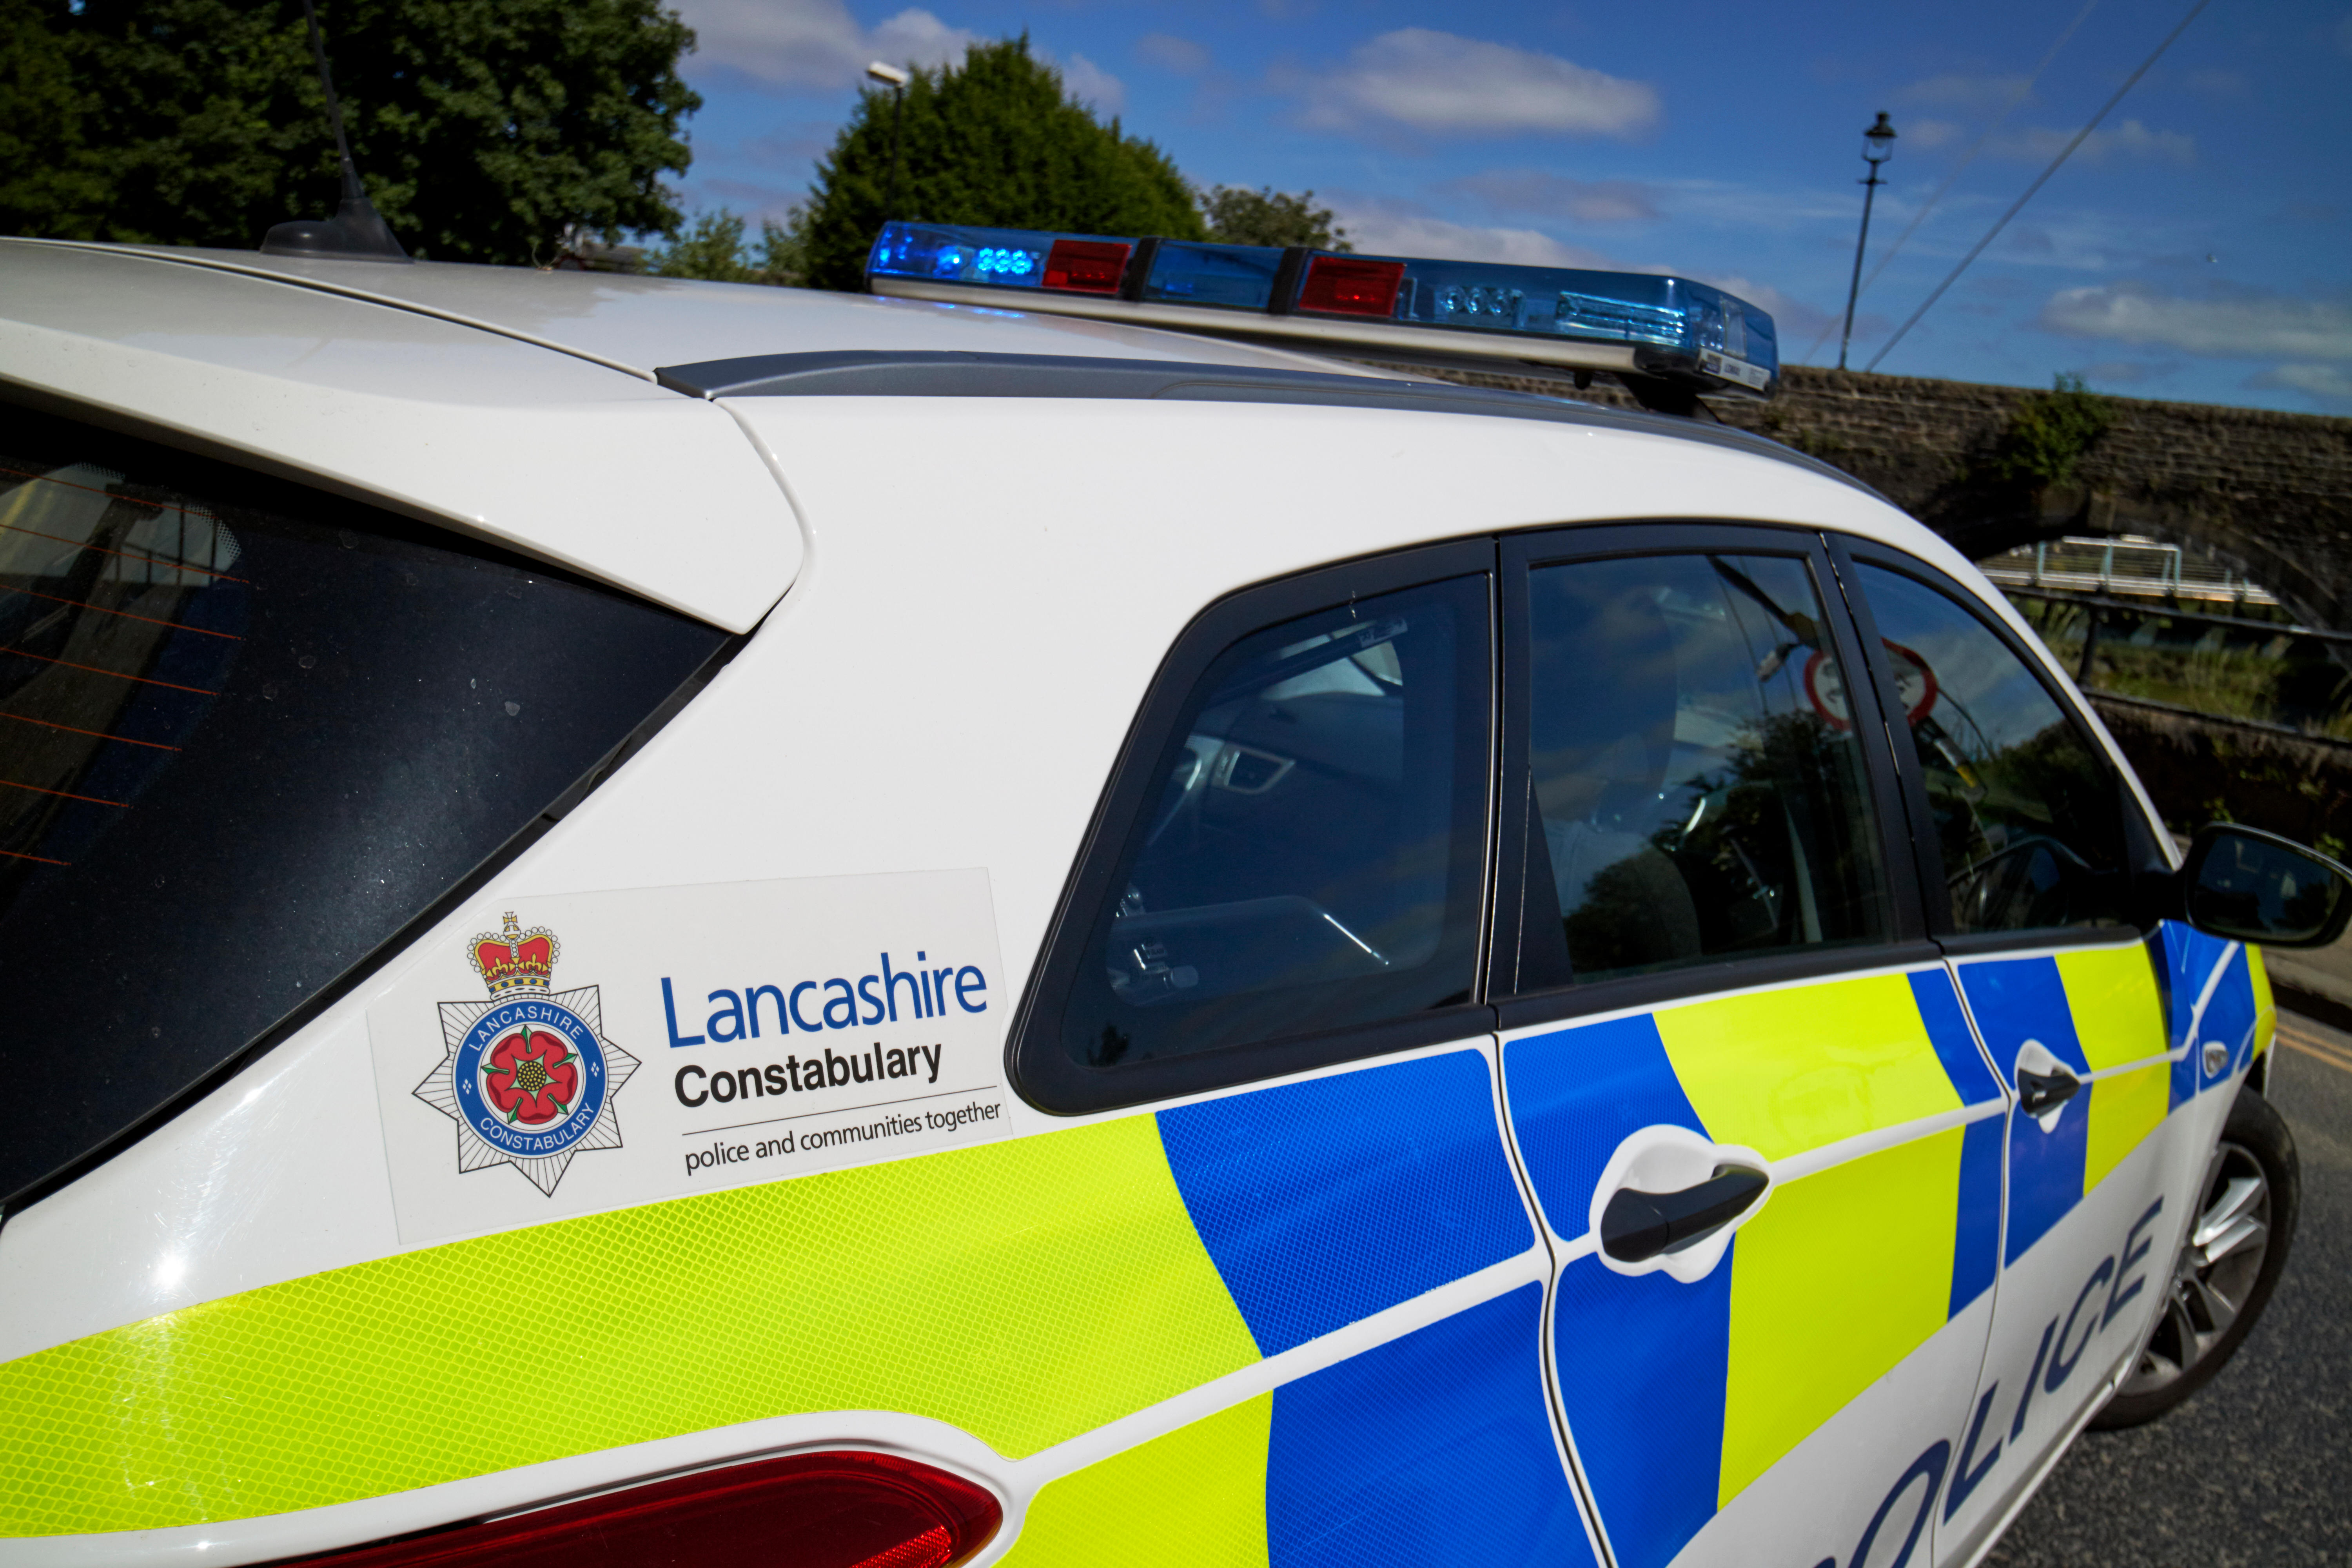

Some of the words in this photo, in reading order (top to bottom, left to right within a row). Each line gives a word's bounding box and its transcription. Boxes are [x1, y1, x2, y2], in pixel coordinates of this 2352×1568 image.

[469, 1006, 584, 1052] LANCASHIRE
[661, 951, 987, 1048] Lancashire
[674, 1042, 941, 1108] Constabulary
[480, 1102, 594, 1151] CONSTABULARY
[685, 1139, 749, 1176] police
[756, 1131, 795, 1158] and
[800, 1115, 922, 1151] communities
[925, 1102, 1001, 1132] together
[1811, 1194, 2164, 1568] OLICE
